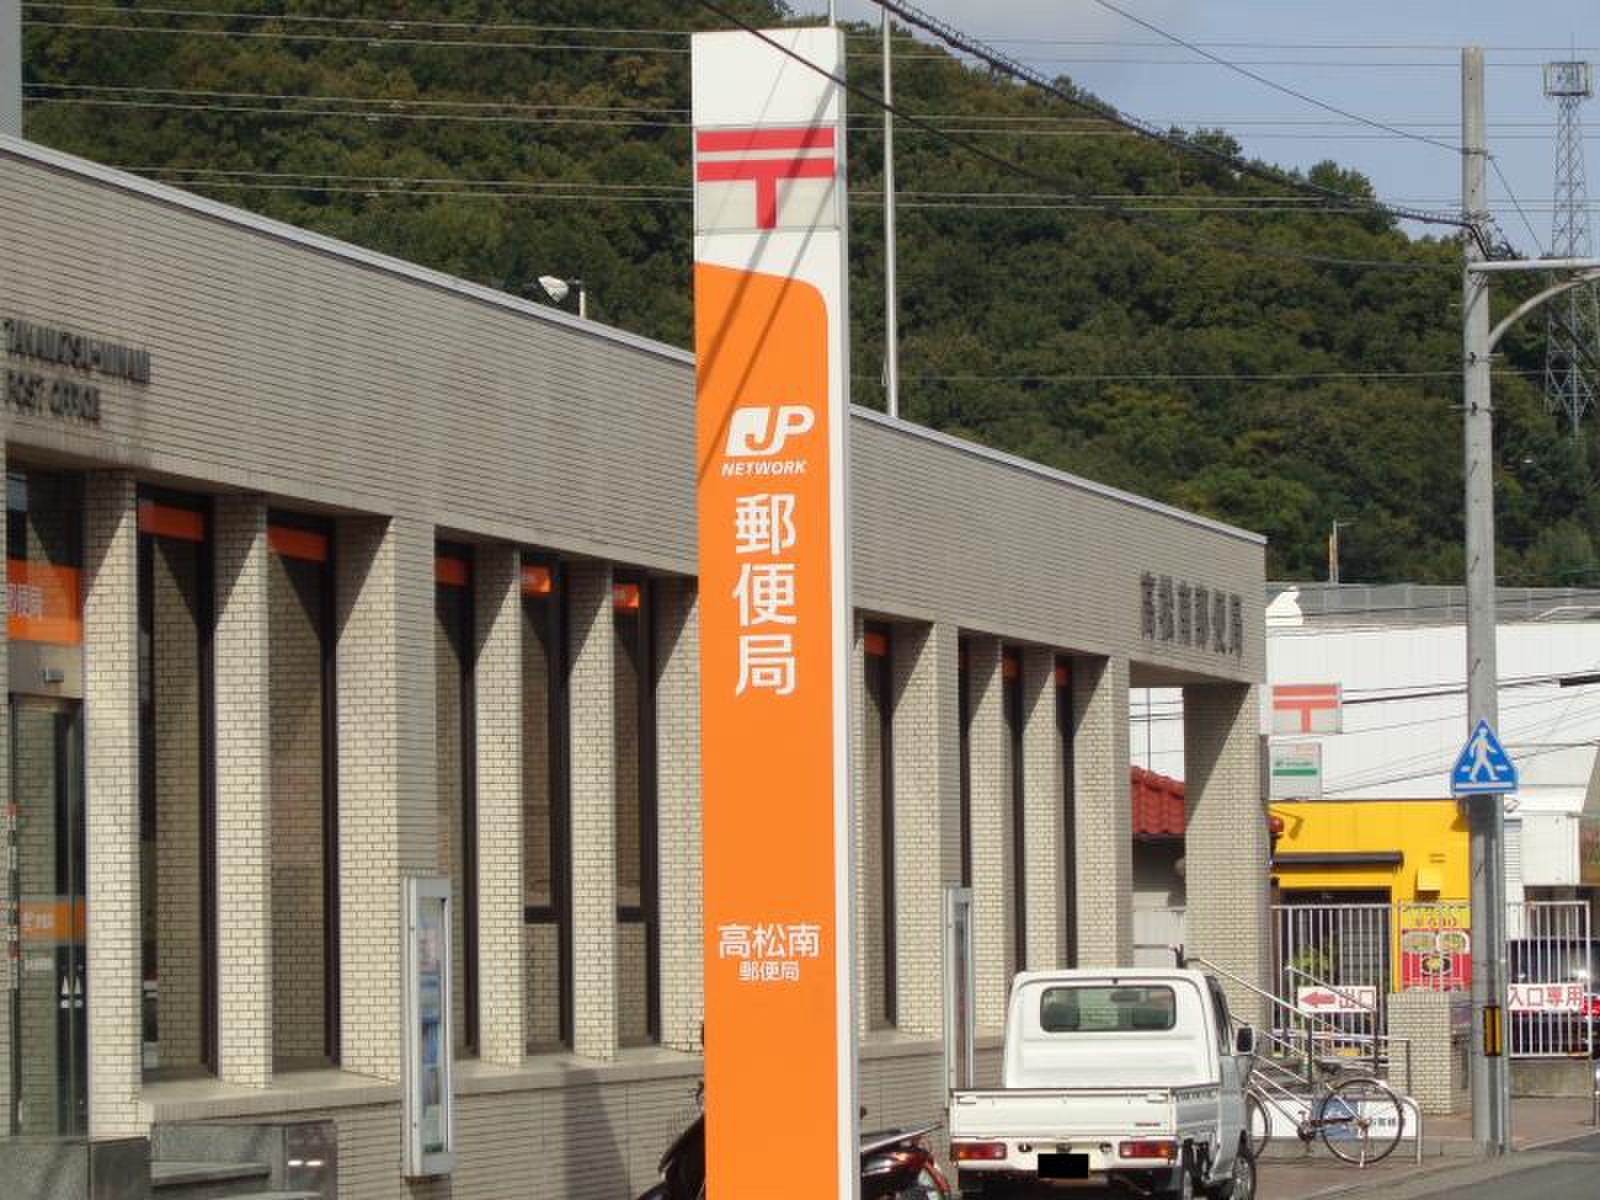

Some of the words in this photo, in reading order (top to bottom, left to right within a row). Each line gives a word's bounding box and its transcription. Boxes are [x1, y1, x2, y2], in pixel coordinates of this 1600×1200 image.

[721, 461, 806, 477] NETWORK
[732, 493, 797, 696] 郵便局
[717, 922, 821, 959] 高松南
[738, 960, 800, 981] 郵便局
[1338, 987, 1377, 1010] 出口
[1507, 986, 1582, 1008] 入口専用
